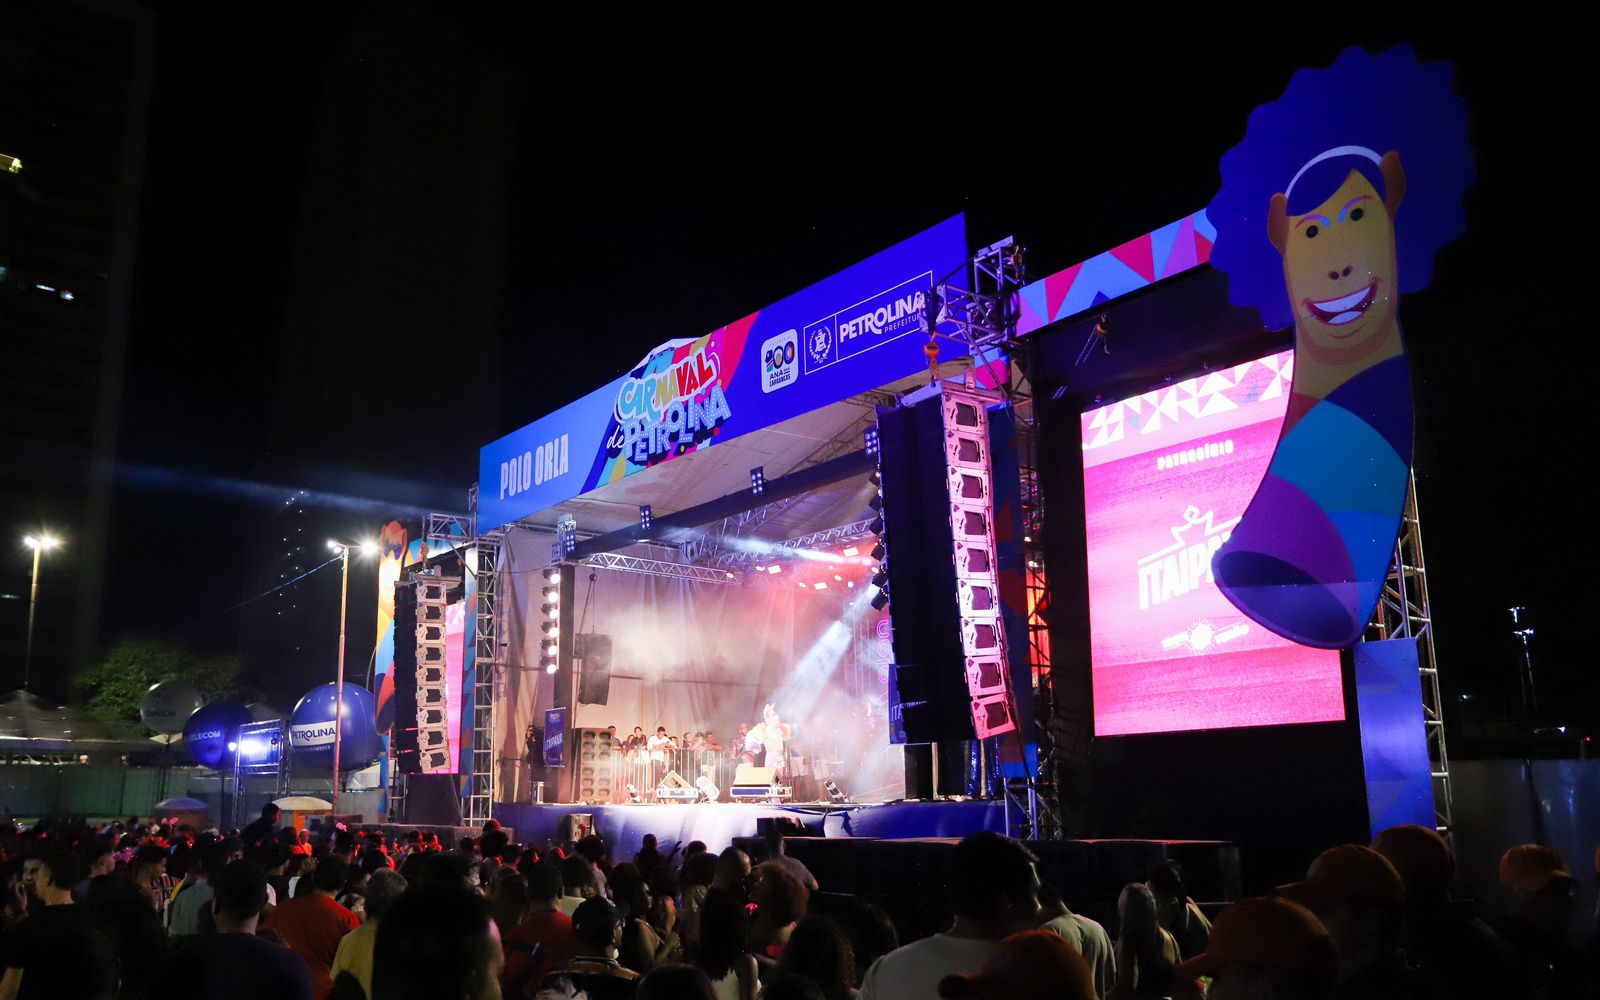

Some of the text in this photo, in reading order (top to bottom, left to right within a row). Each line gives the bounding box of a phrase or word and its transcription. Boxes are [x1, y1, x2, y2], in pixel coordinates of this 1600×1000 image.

[840, 291, 926, 343] PETROLINA
[617, 349, 716, 423] CARNAVAL
[769, 370, 784, 380] ANA
[606, 385, 732, 462] de PETROLINA
[500, 433, 569, 500] POLO ORLA
